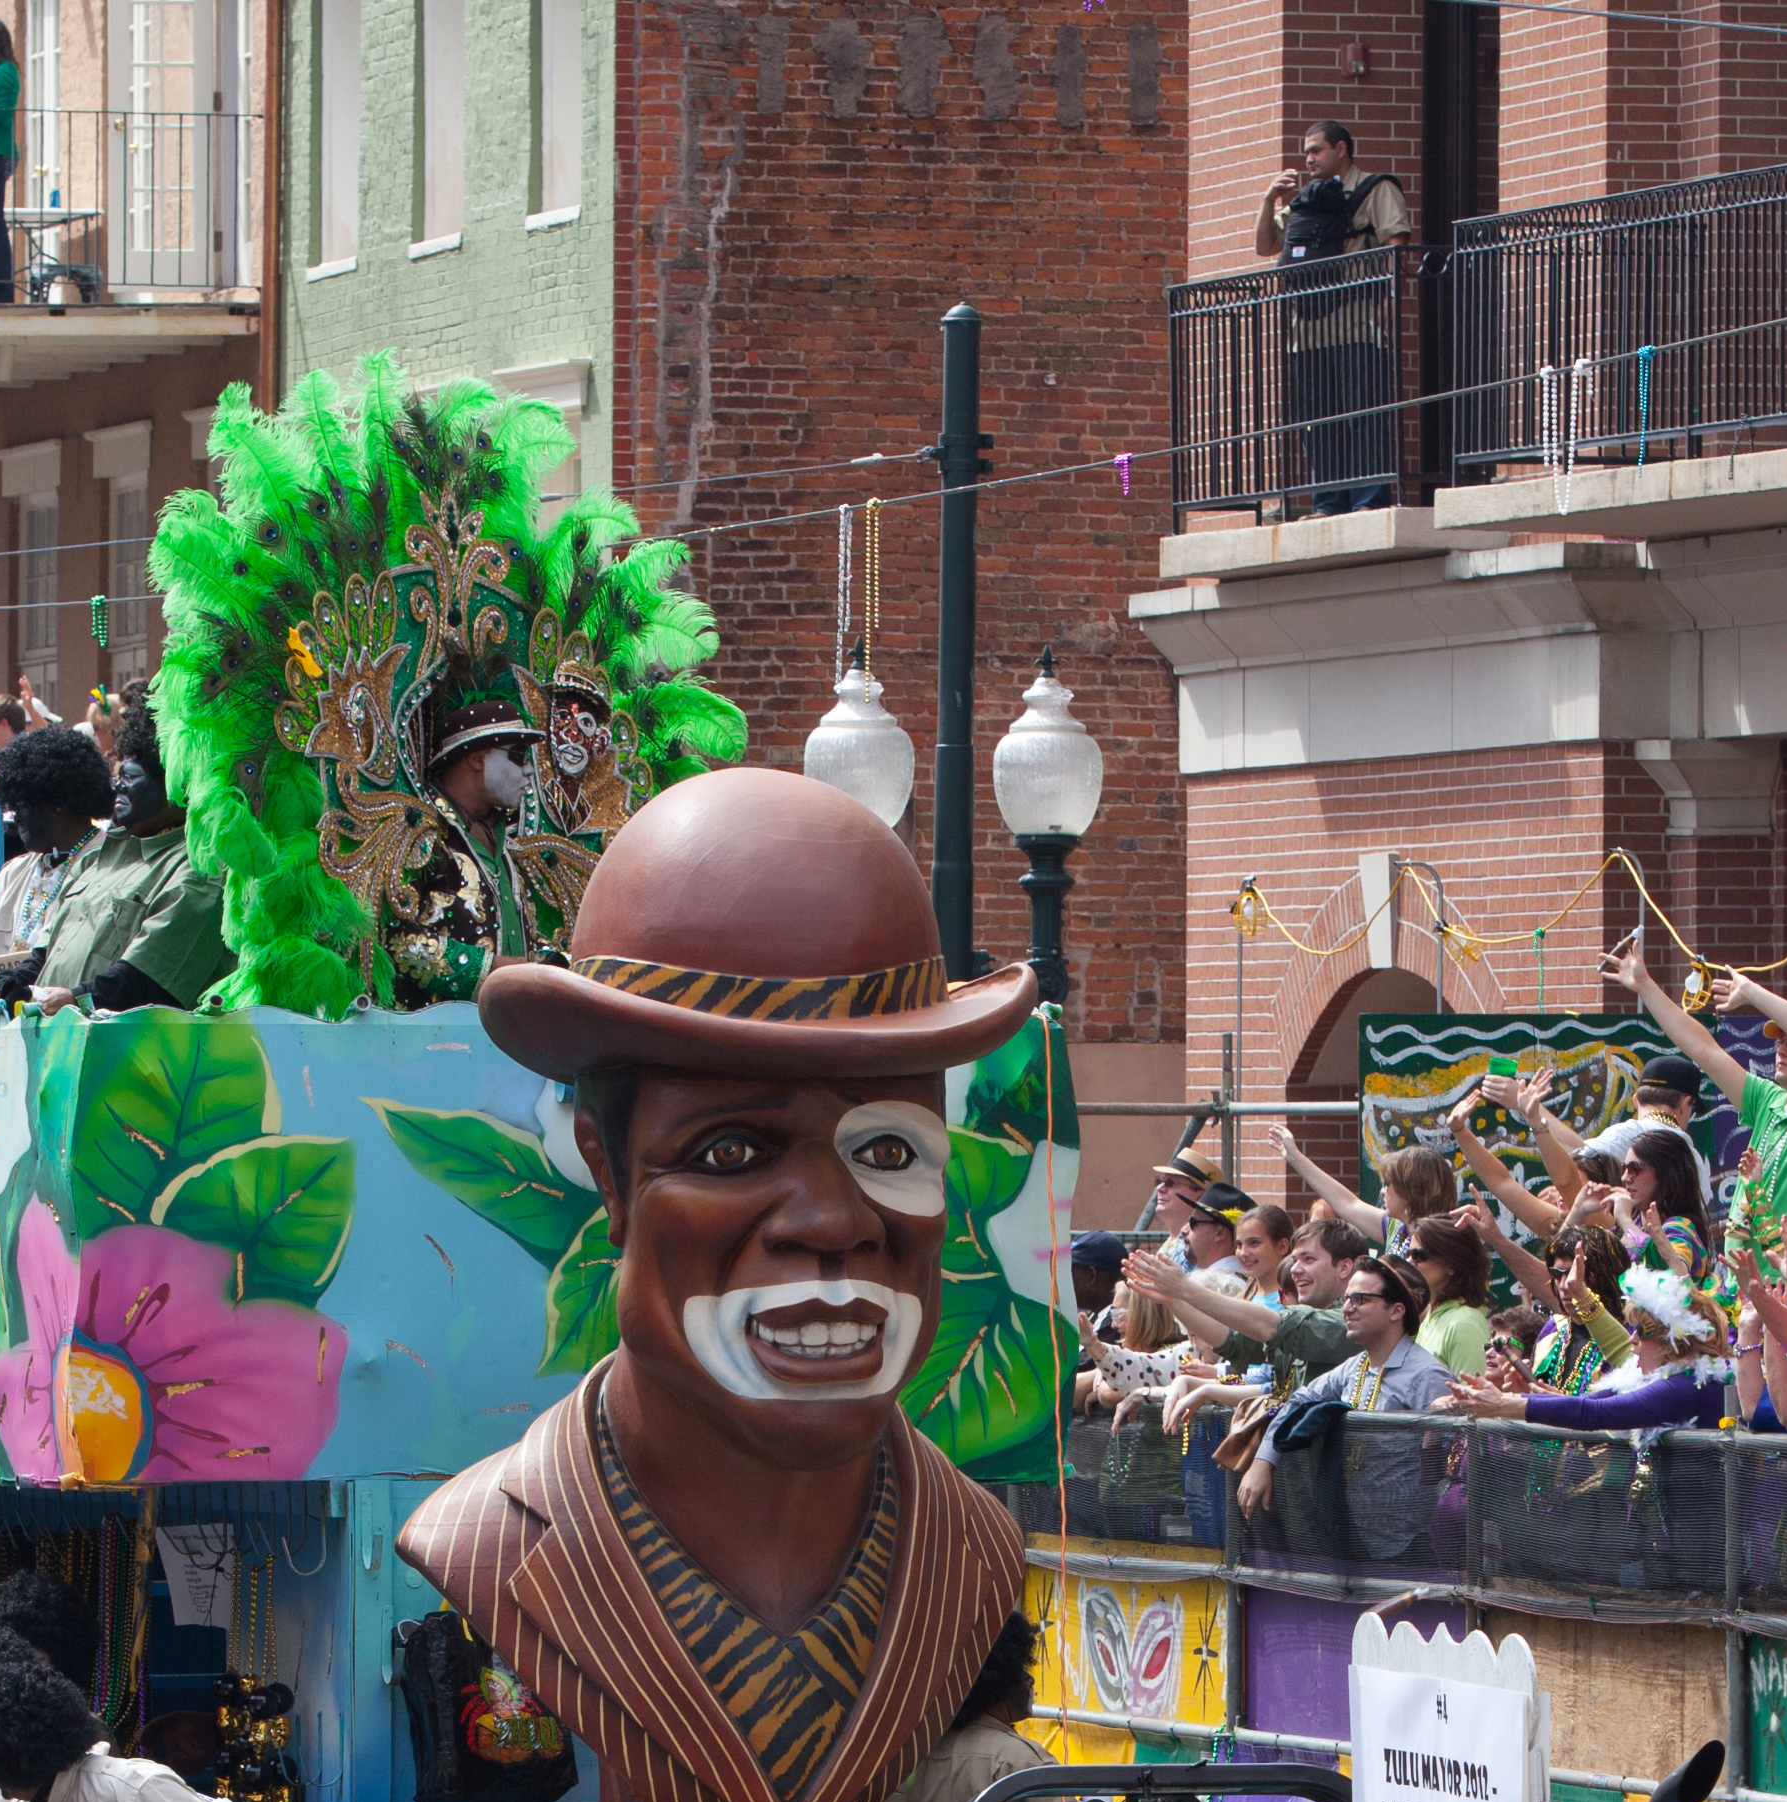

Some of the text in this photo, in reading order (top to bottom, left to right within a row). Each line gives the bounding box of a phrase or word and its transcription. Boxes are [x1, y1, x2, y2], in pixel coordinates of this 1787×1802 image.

[1383, 1747, 1419, 1788] ZULU
[1422, 1753, 1462, 1798] MAYOR
[1463, 1761, 1490, 1802] 2012
